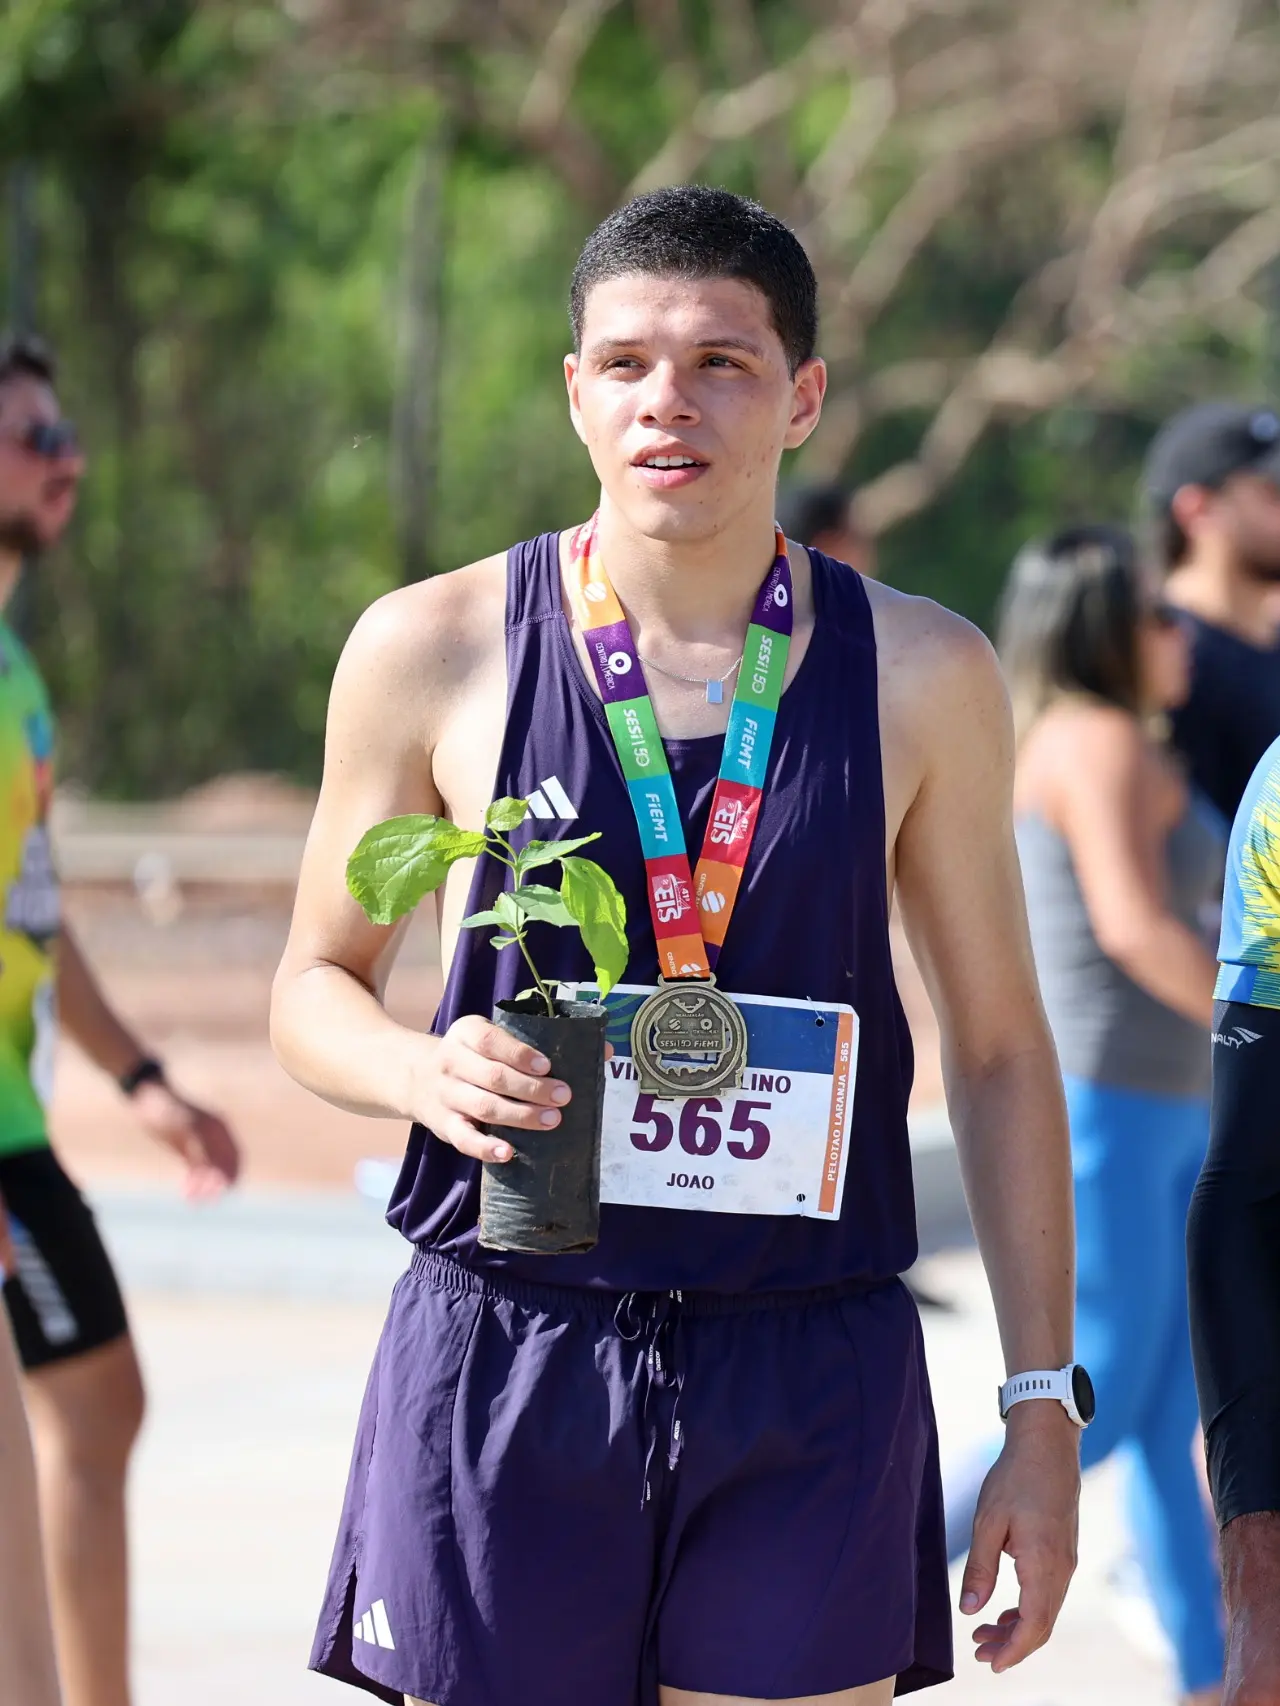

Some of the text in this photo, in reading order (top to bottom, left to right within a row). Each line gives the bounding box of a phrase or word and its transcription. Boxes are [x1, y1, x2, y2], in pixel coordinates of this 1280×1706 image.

[840, 1042, 849, 1062] 565
[1211, 1032, 1243, 1050] NALTY
[834, 1074, 847, 1126] LARANJA
[629, 1094, 772, 1161] 565
[827, 1129, 841, 1182] PELOTAO
[666, 1173, 715, 1190] JOAO
